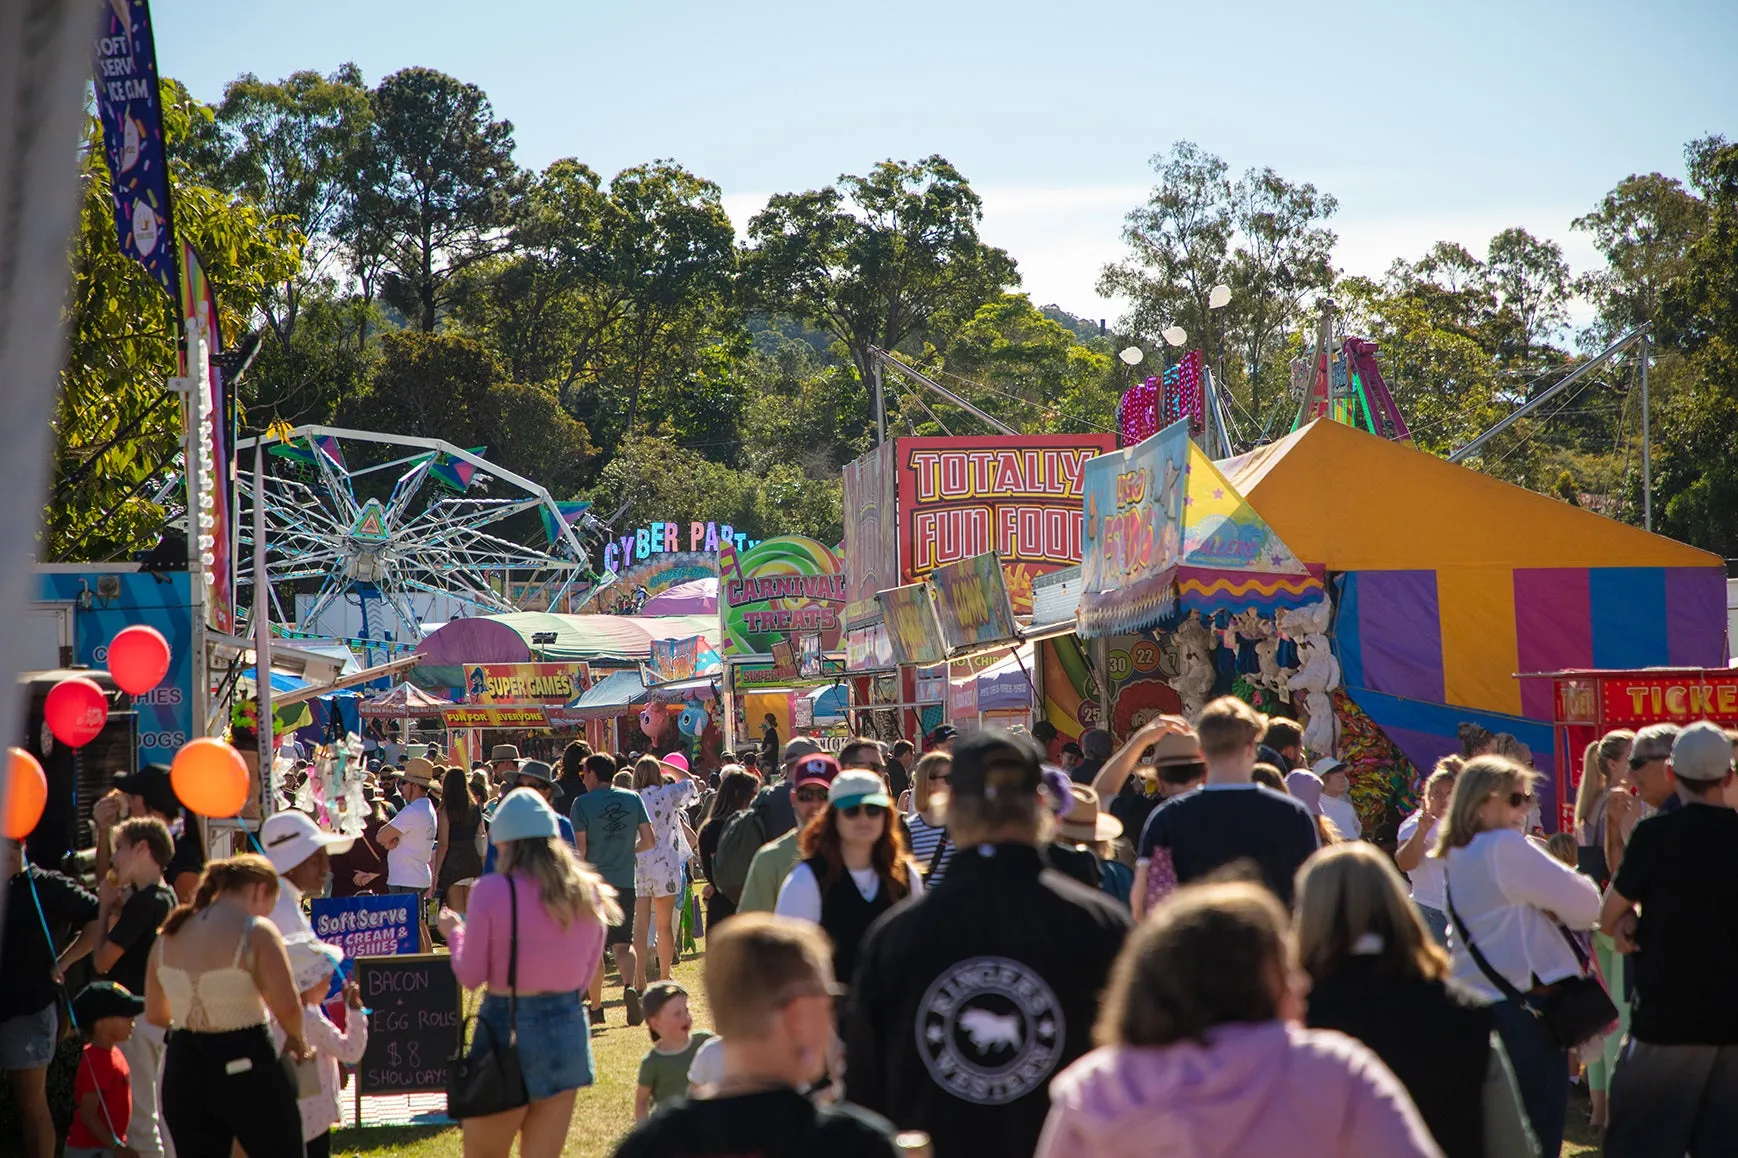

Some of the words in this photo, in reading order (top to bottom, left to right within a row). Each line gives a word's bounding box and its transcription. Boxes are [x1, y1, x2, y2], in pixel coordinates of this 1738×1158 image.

[912, 450, 1085, 501] TOTALLY
[604, 521, 679, 573] CYBER
[915, 507, 993, 570] FUN
[728, 575, 846, 608] CARNIVAL
[743, 609, 837, 634] TREATS
[974, 656, 1004, 667] CHIP
[1110, 657, 1127, 673] 30
[1137, 649, 1154, 664] 22
[487, 676, 528, 698] SUPER
[528, 675, 572, 698] GAMES
[447, 713, 467, 722] FUN
[467, 713, 488, 722] FOR
[495, 712, 543, 722] EVERYONE
[1084, 708, 1101, 722] 25
[345, 927, 396, 946] CREAM
[398, 926, 409, 939] &
[345, 939, 398, 957] USHIES
[368, 971, 429, 996] BACON
[373, 1010, 409, 1032] EGG
